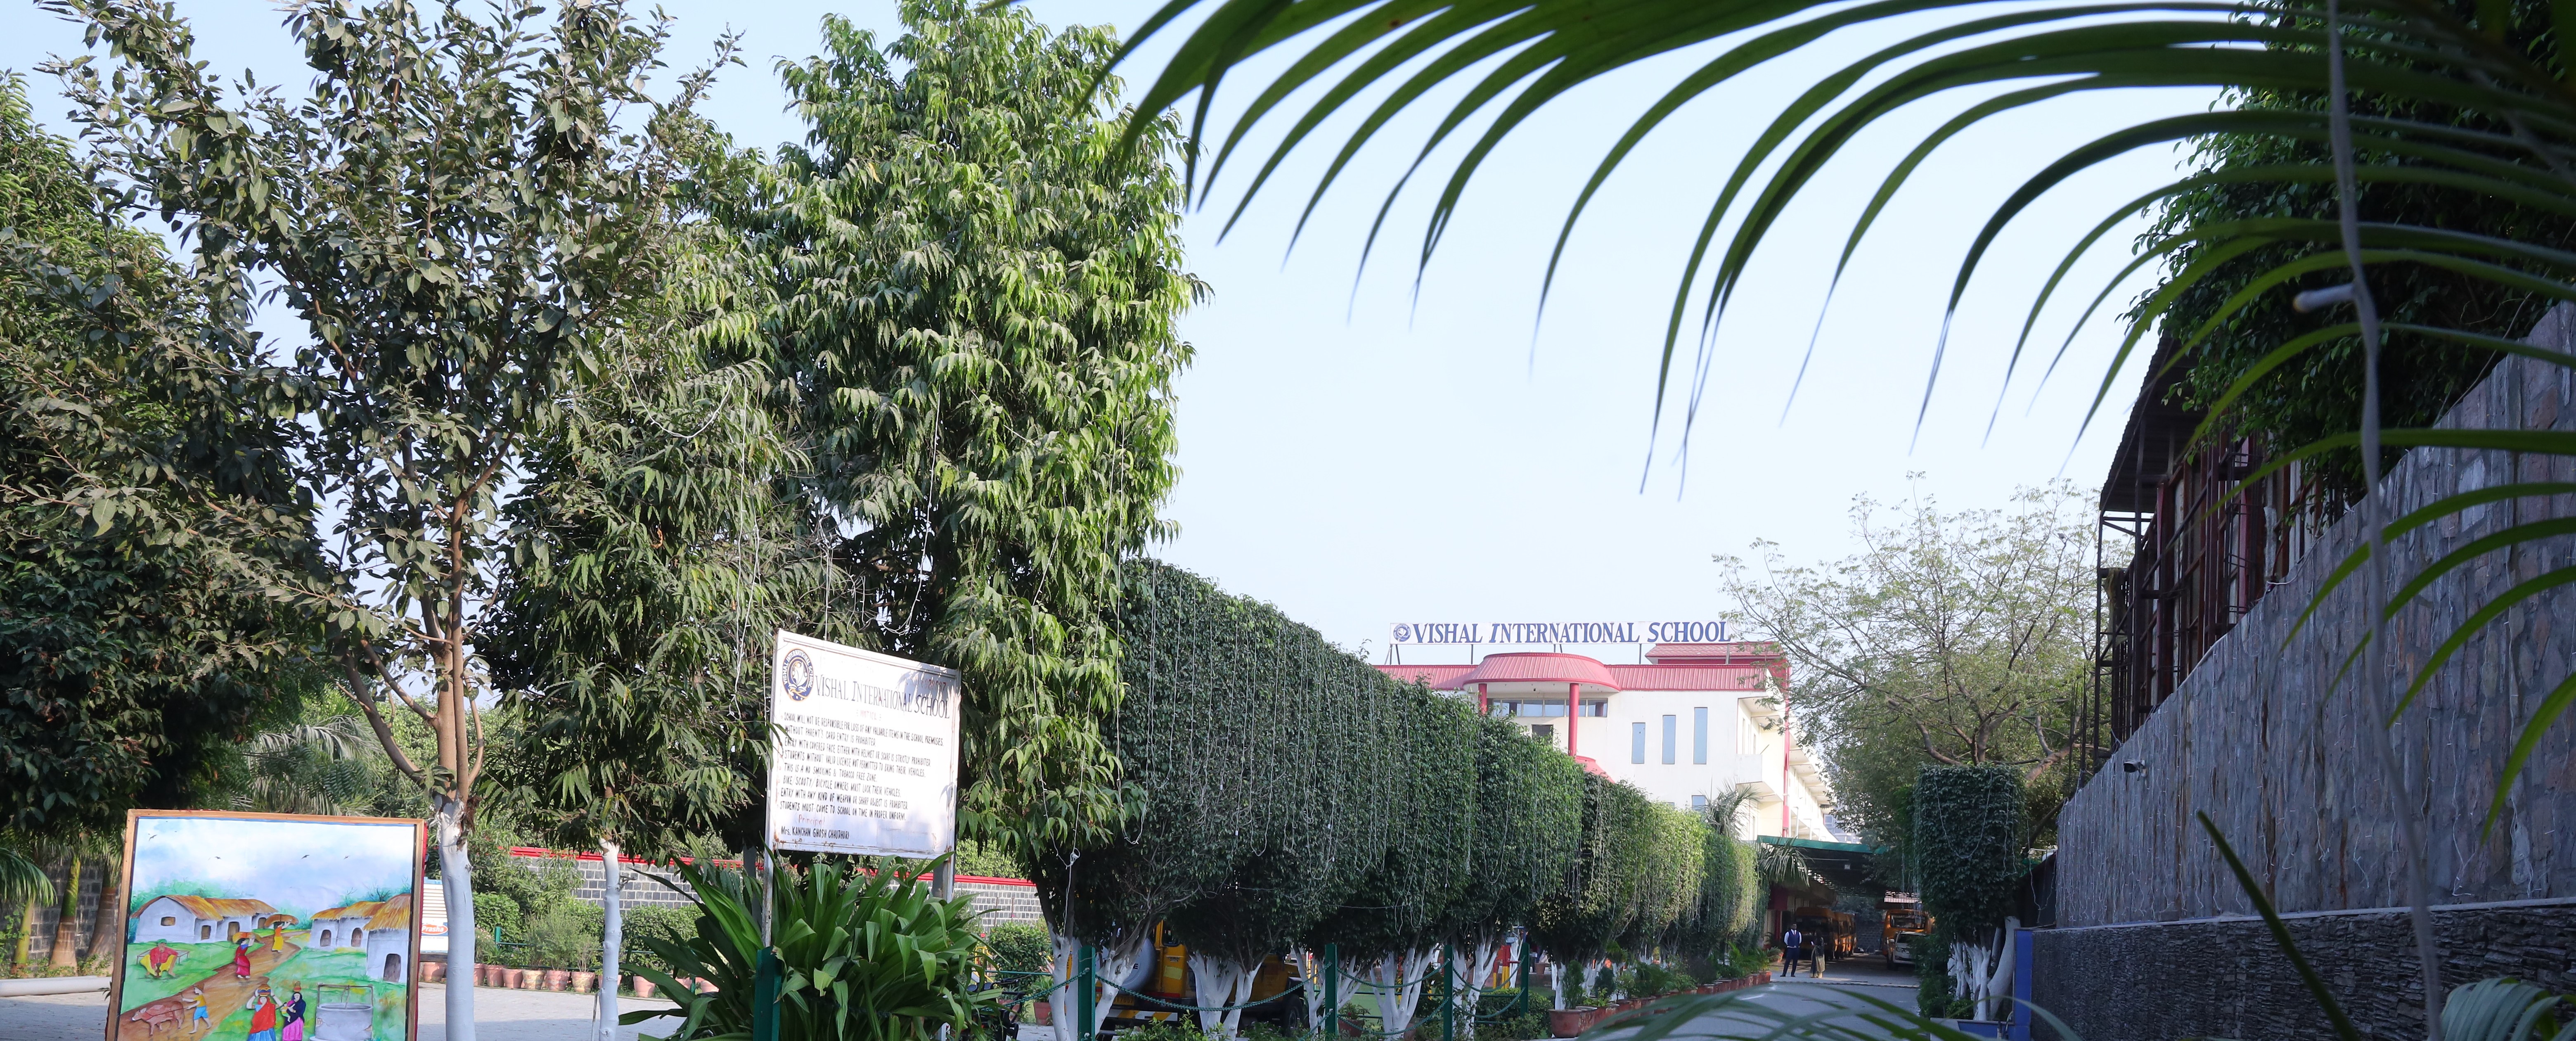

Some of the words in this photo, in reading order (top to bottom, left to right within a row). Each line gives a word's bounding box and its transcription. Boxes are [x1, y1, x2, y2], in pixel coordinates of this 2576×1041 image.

[1413, 623, 1483, 643] VISHAL
[1489, 622, 1640, 643] INTERNATIONAL
[1648, 621, 1731, 643] SCHOOL
[786, 650, 810, 666] INTERNATIONAL
[815, 674, 848, 700] VISHAL
[851, 681, 912, 712] INTERNATIONAL
[914, 694, 949, 719] SCHOOL
[784, 711, 796, 722] SCHOOL
[815, 716, 820, 726] BE
[821, 717, 843, 730] RESPONSIBLE
[860, 724, 864, 732] OF
[888, 729, 899, 739] ITEMS
[911, 733, 923, 743] SCHOOL
[785, 724, 803, 736] WITHOUT
[826, 730, 835, 740] CARD
[837, 732, 848, 742] ENTRY
[850, 735, 854, 743] IS
[784, 749, 804, 761] STUDENTS
[807, 752, 824, 763] WITHOUT
[826, 755, 836, 764] VALID
[837, 756, 851, 767] LICENSE
[860, 759, 878, 771] PERMITTED
[879, 762, 883, 771] TO
[885, 764, 894, 773] BRING
[896, 765, 906, 774] THEIR
[799, 739, 808, 749] WITH
[810, 740, 825, 751] COVERED
[826, 743, 835, 753] FACE
[837, 745, 850, 755] EITHER
[851, 747, 859, 756] WITH
[861, 748, 874, 759] HELMET
[876, 751, 879, 759] OR
[881, 752, 890, 761] SCARF
[895, 754, 910, 764] STRICTLY
[784, 762, 793, 772] THIS
[795, 764, 799, 773] IS
[800, 764, 803, 773] A
[805, 765, 810, 773] NO
[813, 766, 831, 776] SMOKING
[839, 768, 854, 779] TOBACCO
[856, 771, 865, 780] FREE
[781, 787, 793, 798] ENTRY
[796, 788, 805, 799] WITH
[807, 790, 816, 799] ANY
[818, 791, 827, 801] KIND
[830, 792, 834, 802] OF
[836, 793, 851, 804] WEAPON
[853, 795, 857, 804] OR
[859, 796, 869, 805] SHARP
[870, 797, 882, 807] OBJECT
[884, 799, 887, 807] IS
[834, 780, 848, 791] OWNERS
[850, 782, 860, 792] MUST
[872, 785, 882, 795] THEIR
[780, 800, 800, 811] STUDENTS
[802, 802, 814, 812] MUST
[816, 804, 828, 813] COME
[830, 805, 835, 814] TO
[837, 806, 850, 816] SCHOOL
[852, 807, 857, 816] ON
[858, 808, 867, 817] TIME
[869, 809, 873, 818] IN
[874, 809, 887, 819] PROPER
[889, 811, 906, 821] UNIFORM.
[781, 825, 791, 836] Mrs.
[792, 826, 810, 837] KANCHAN
[813, 827, 826, 839] GHOSH
